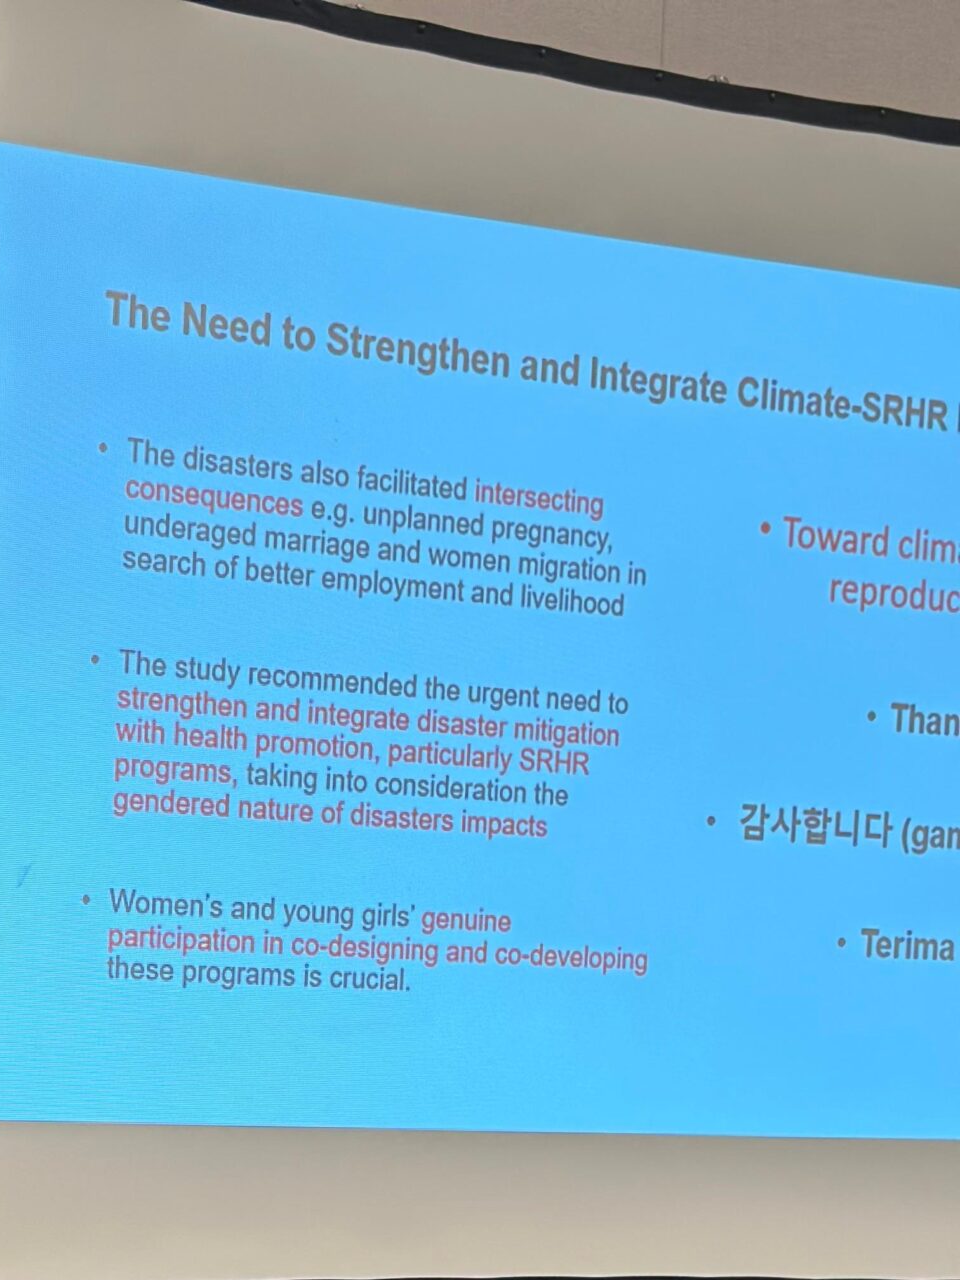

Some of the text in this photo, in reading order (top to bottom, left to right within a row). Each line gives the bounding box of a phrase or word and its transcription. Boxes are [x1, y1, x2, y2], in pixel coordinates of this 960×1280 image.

[105, 289, 171, 333] The
[182, 301, 272, 347] Need
[281, 315, 317, 353] to
[326, 321, 510, 379] Strengthen
[519, 353, 581, 387] and
[590, 355, 728, 405] Integrate
[737, 375, 949, 432] Climate-SRHR
[127, 436, 604, 522] The disasters also facilitated intersecting
[125, 479, 613, 556] consequences e.g. unplanned pregnancy,
[782, 515, 960, 565] Toward clim
[124, 512, 647, 587] underaged marriage and women migration in
[122, 550, 625, 617] search of better employment and livelihood
[829, 578, 960, 614] reproduc
[119, 648, 629, 715] The study recommended the urgent need to
[117, 686, 620, 749] strengthen and integrate disaster mitigation
[890, 701, 960, 737] Than
[115, 717, 590, 777] with health promotion, particularly SRHR
[114, 757, 569, 807] programs, taking into consideration the
[113, 788, 548, 841] gendered nature of disasters impacts
[739, 803, 894, 849] 감사합니다
[230, 896, 276, 921] and
[282, 903, 355, 932] young
[421, 907, 512, 936] genuine
[107, 924, 648, 977] participation in co-designing and co-developing
[860, 927, 955, 962] Terima
[106, 954, 411, 993] these programs is crucial.
